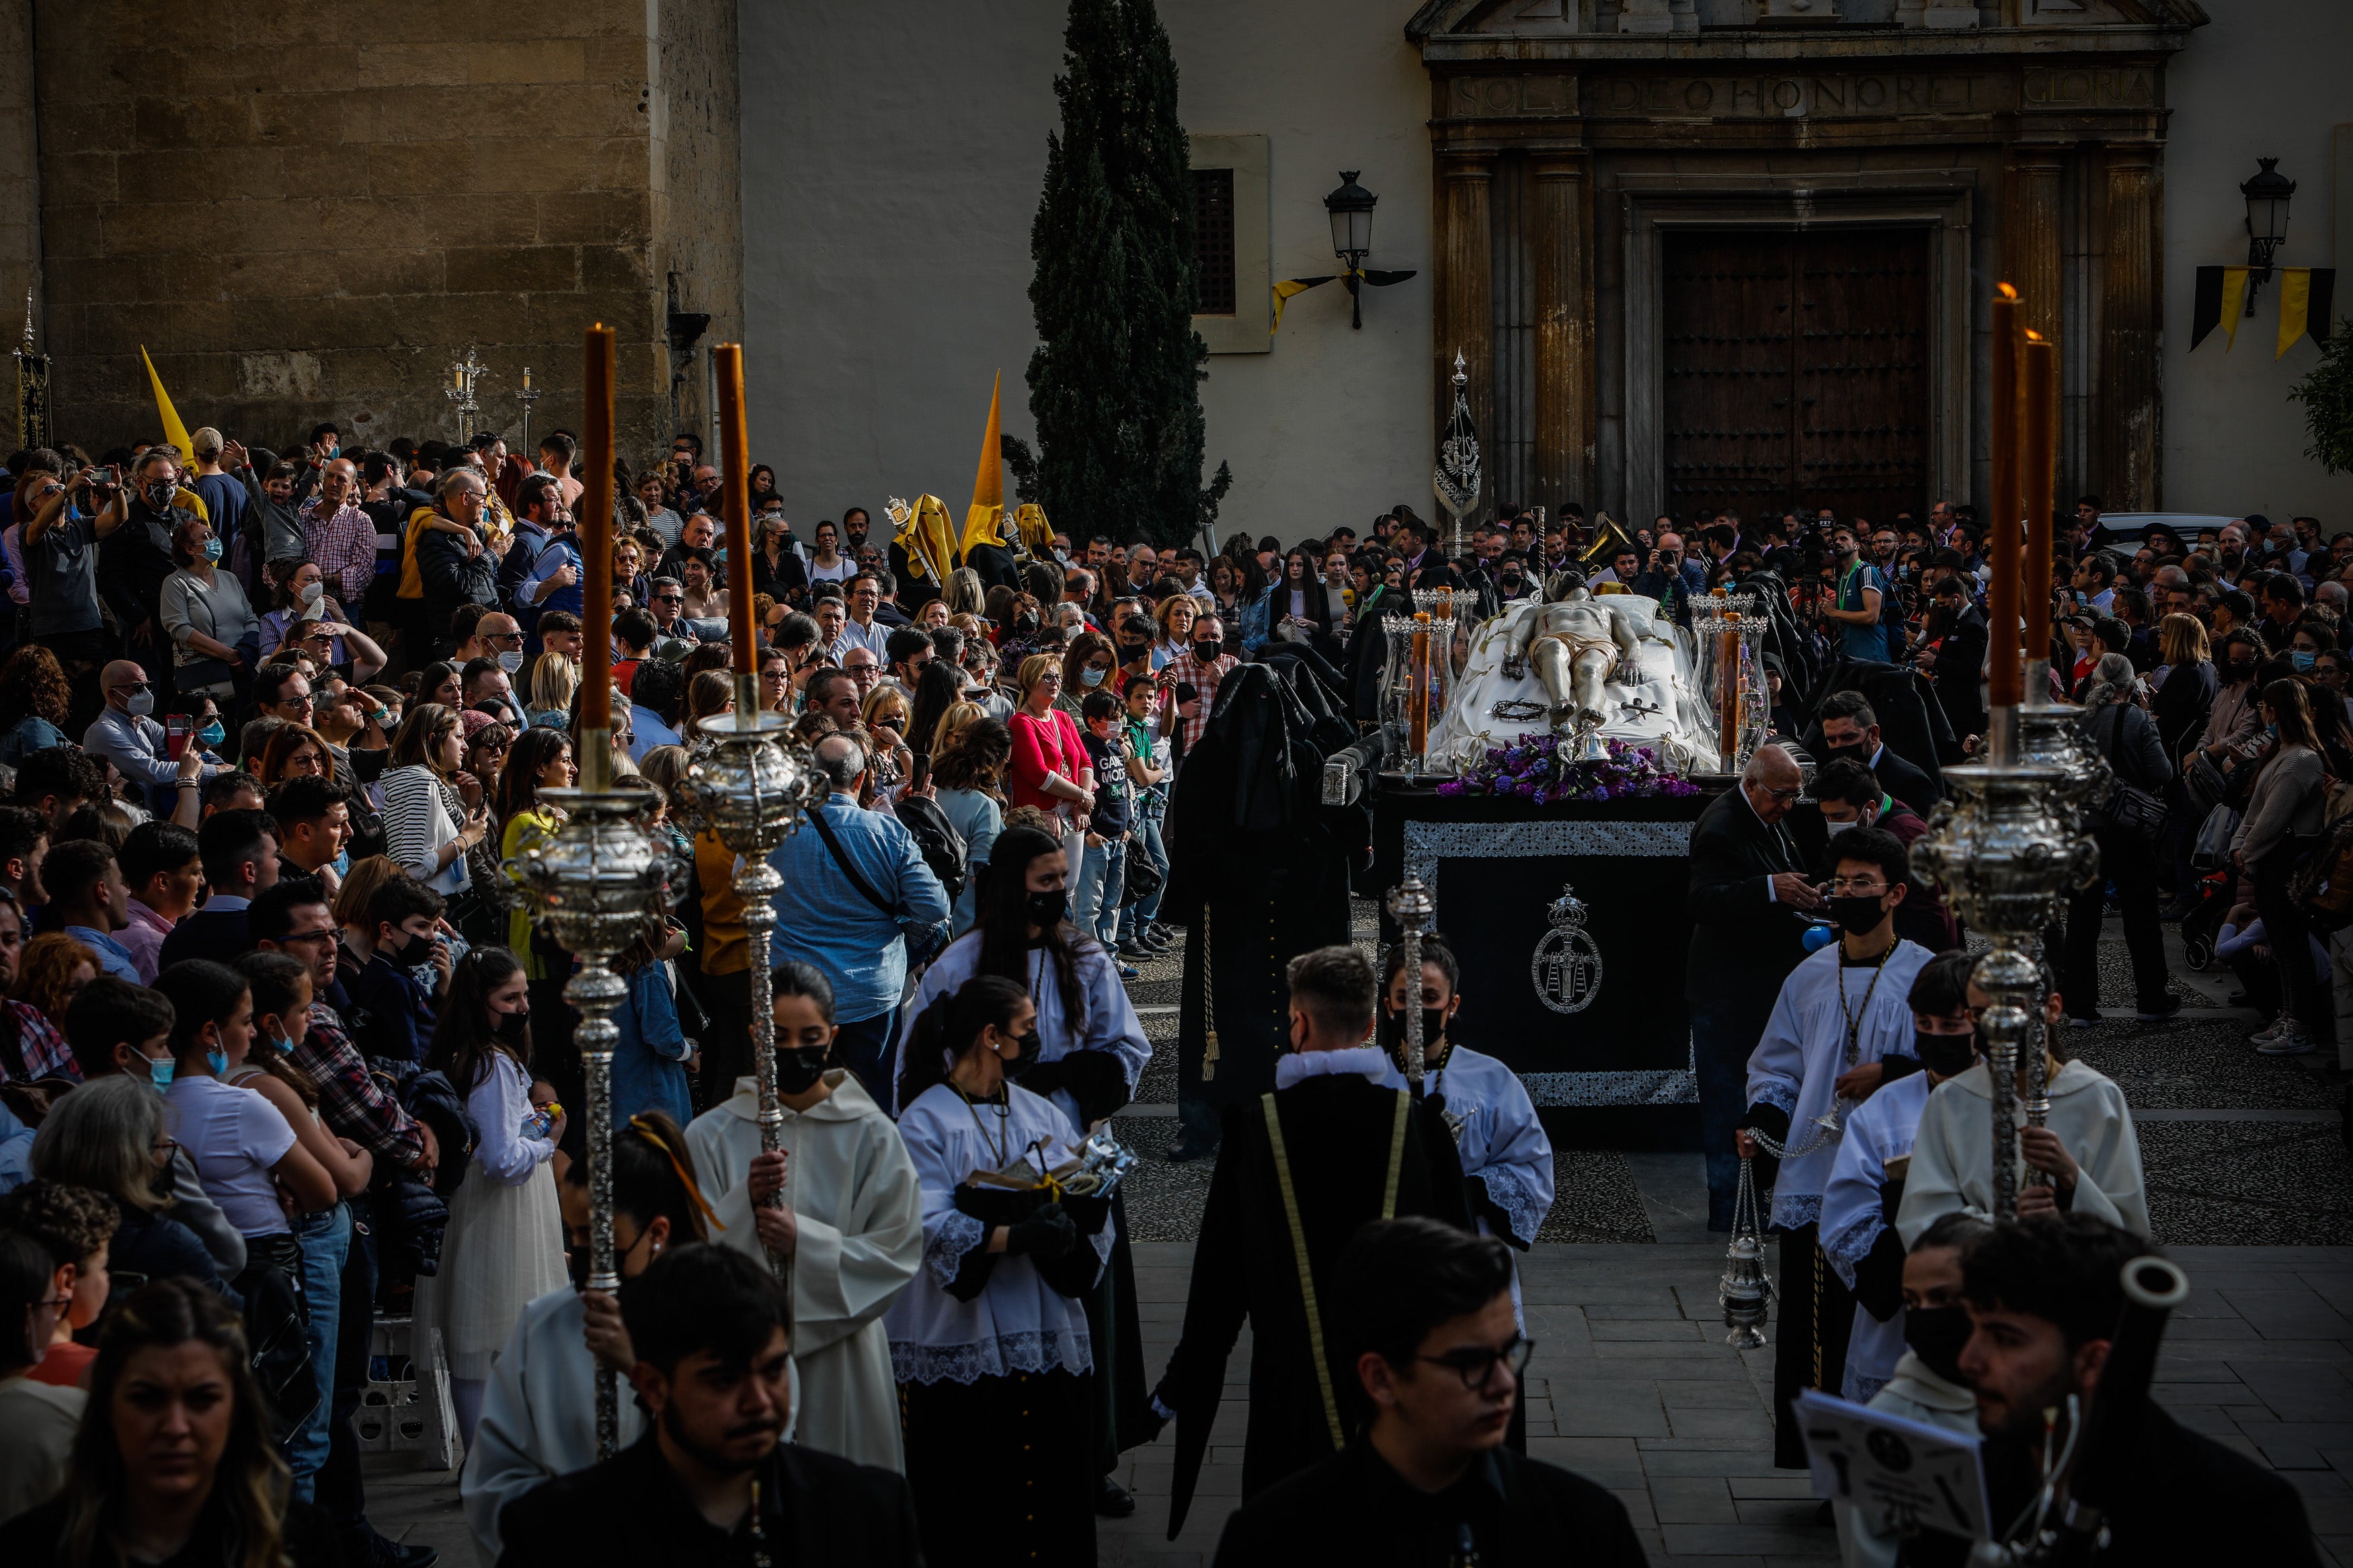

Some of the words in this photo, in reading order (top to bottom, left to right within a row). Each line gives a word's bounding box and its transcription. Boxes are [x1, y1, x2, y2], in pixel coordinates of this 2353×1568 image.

[1458, 76, 1568, 116] SOLI
[1611, 79, 1713, 111] DEO
[2024, 71, 2153, 102] GLORIA
[1099, 755, 1123, 770] GAME
